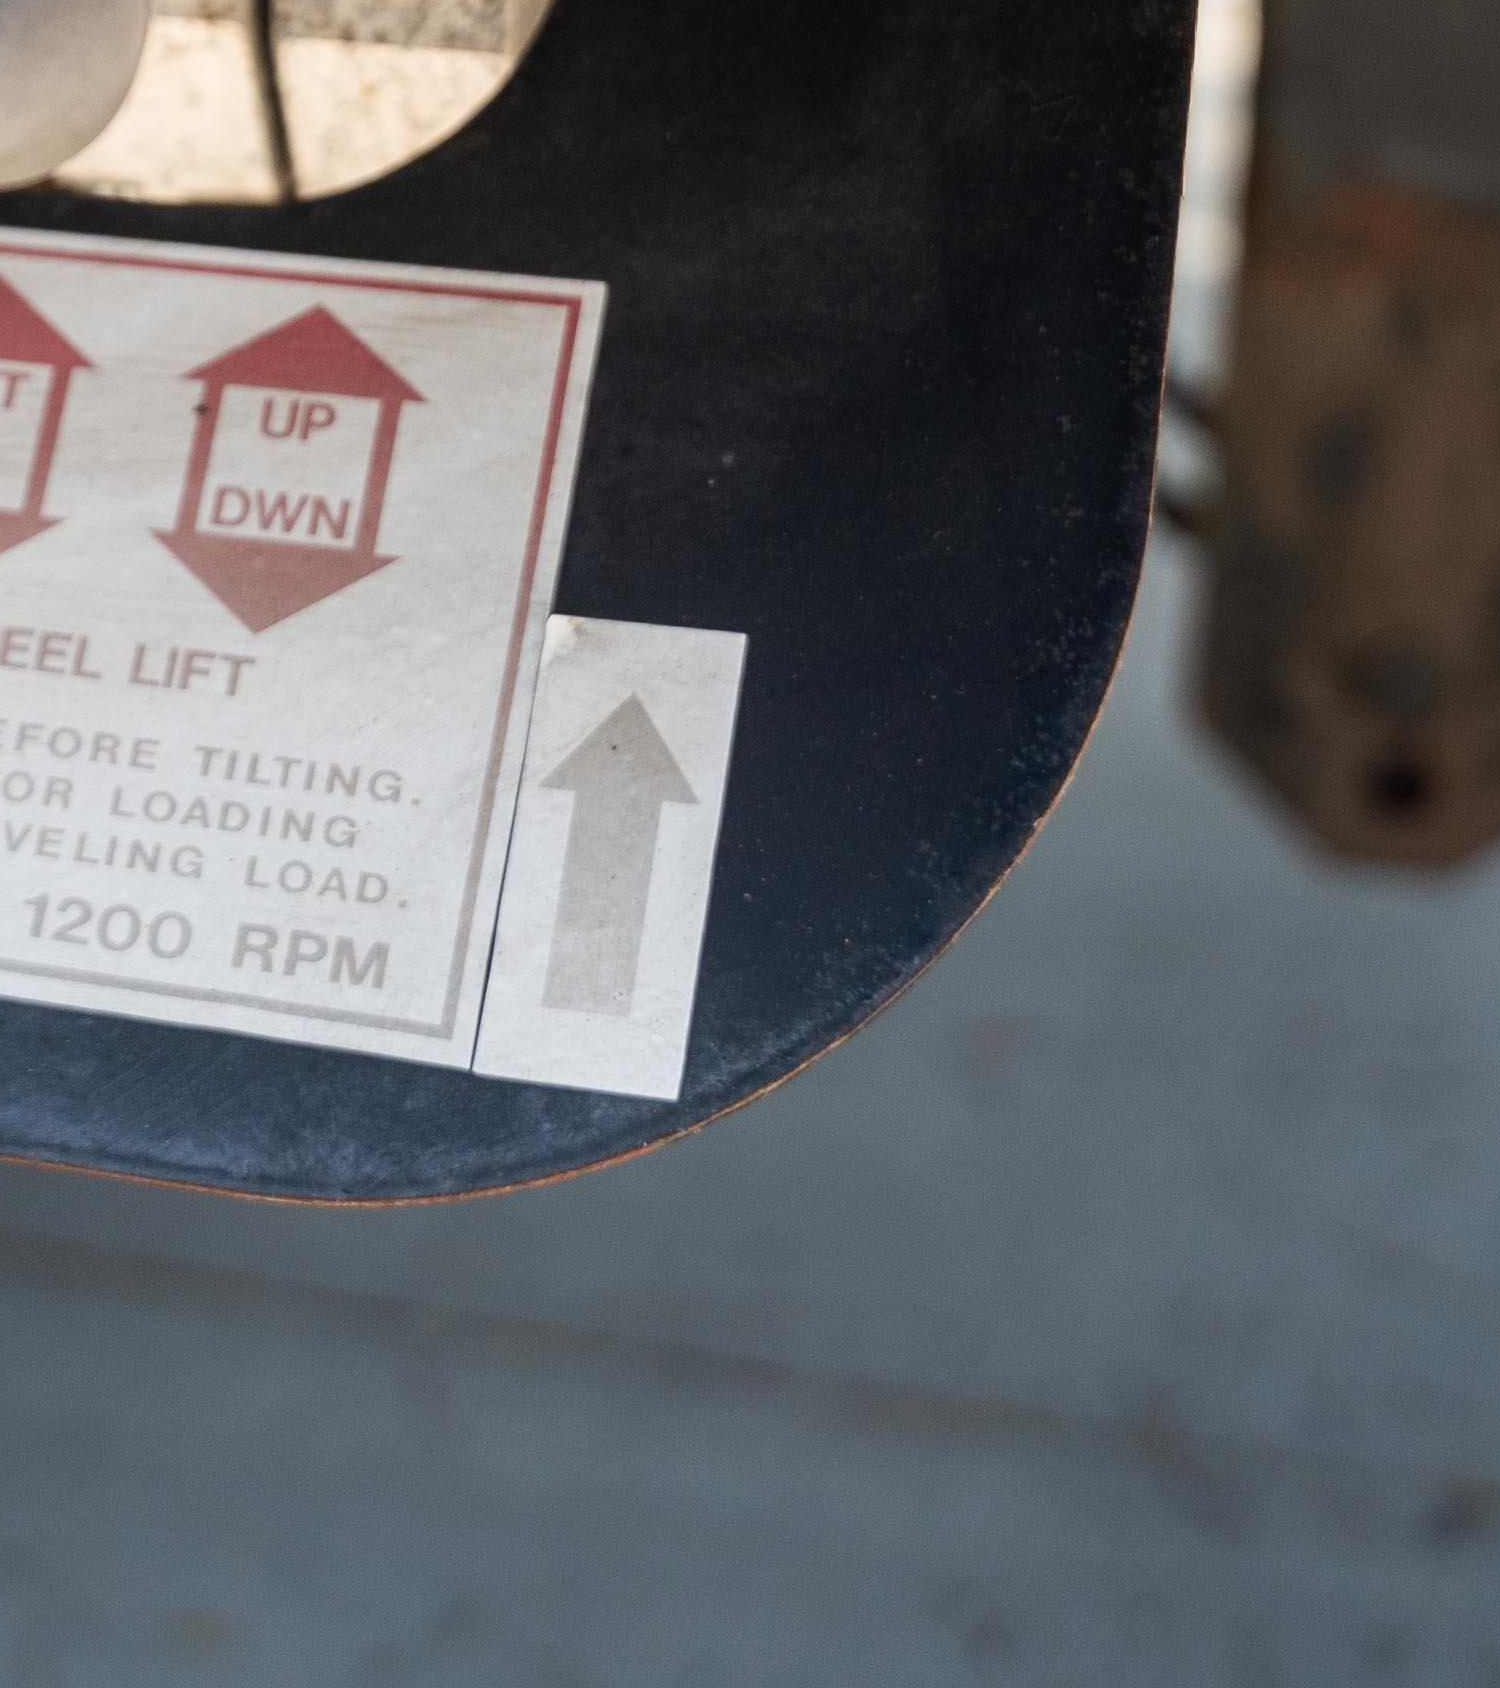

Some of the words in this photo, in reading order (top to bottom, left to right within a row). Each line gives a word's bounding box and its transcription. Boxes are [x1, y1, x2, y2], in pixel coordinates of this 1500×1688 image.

[258, 398, 337, 443] UP
[209, 484, 352, 541] DWN
[127, 640, 257, 697] LIFT
[193, 744, 423, 808] TILTING.
[110, 786, 361, 851] LOADING
[242, 854, 411, 912] LOAD.
[22, 890, 196, 963] 1200
[229, 920, 392, 992] RPM
